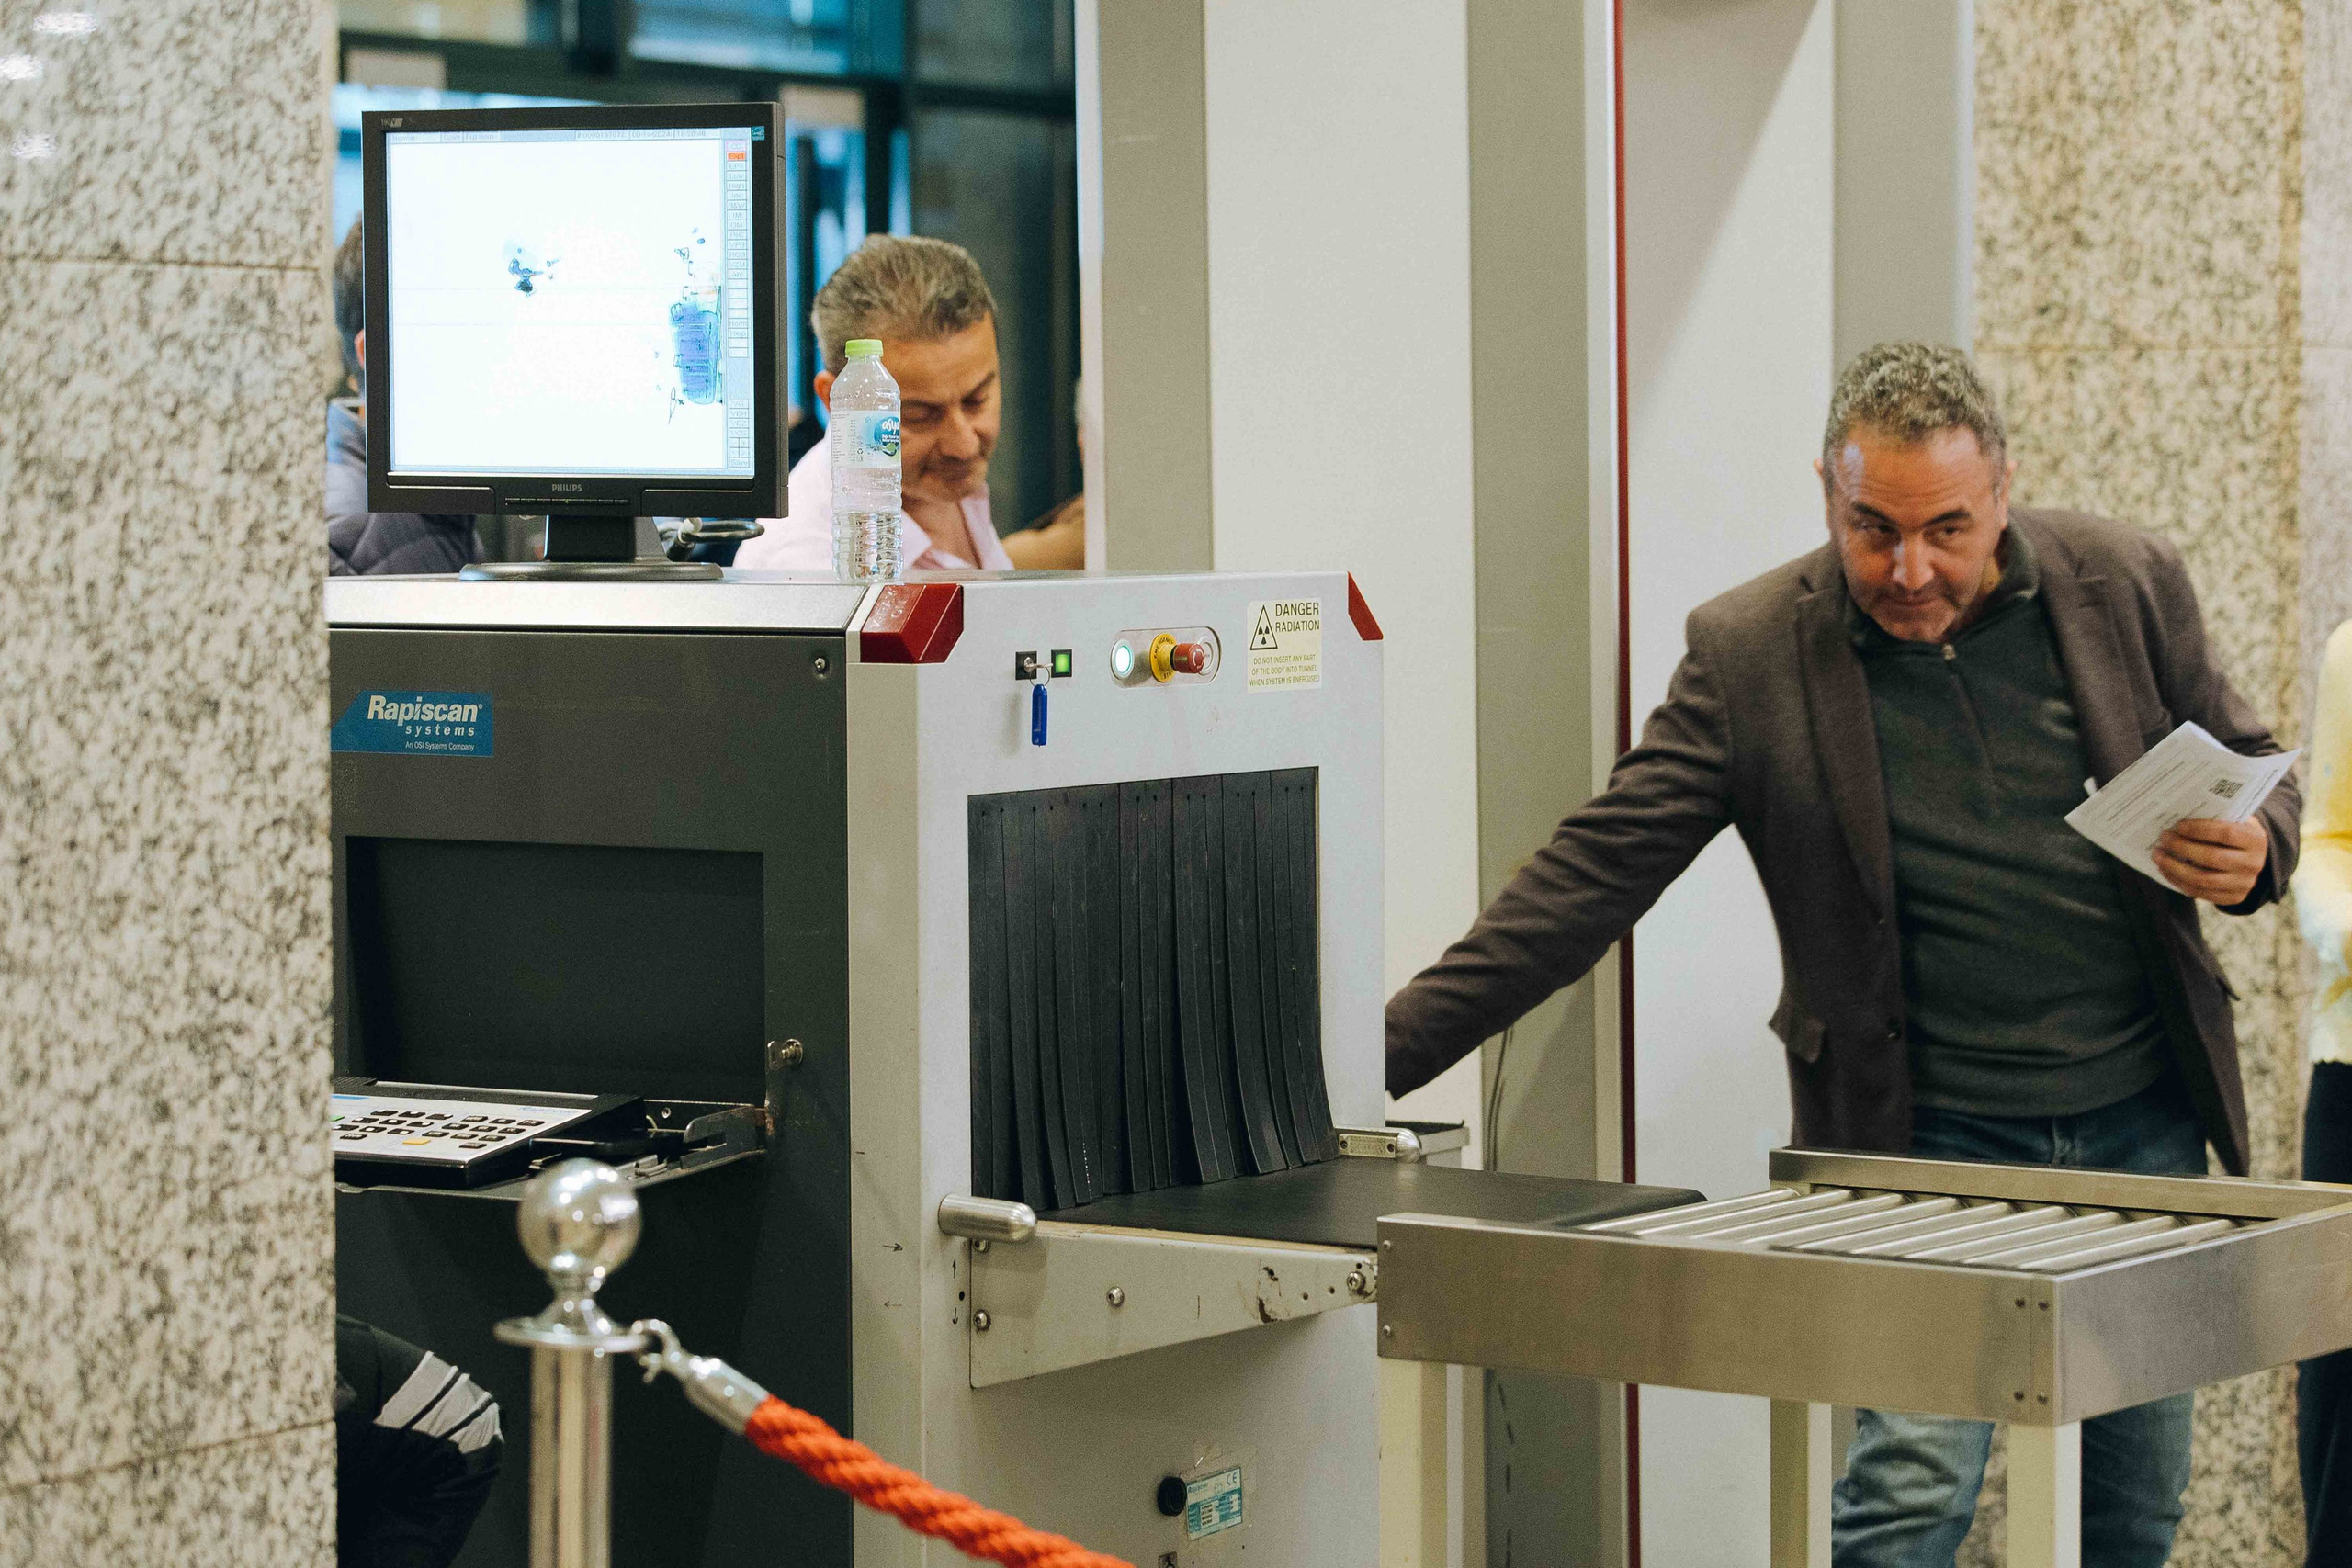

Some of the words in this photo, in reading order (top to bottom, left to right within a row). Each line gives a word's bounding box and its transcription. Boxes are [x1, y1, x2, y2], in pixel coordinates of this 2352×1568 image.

[551, 483, 582, 492] PHILIPS
[1275, 602, 1319, 616] DANGER
[1275, 619, 1319, 633] RADIATION
[1253, 657, 1261, 665] DO
[1261, 656, 1272, 664] NOT
[1273, 655, 1291, 663] INSERT
[1251, 668, 1259, 676] OF
[1260, 667, 1270, 675] THE
[1271, 666, 1284, 674] BODY
[1285, 665, 1297, 673] INTO
[1298, 664, 1317, 672] TUNNEL
[1249, 679, 1265, 687] WHEN
[1265, 677, 1285, 685] SYSTEM
[1286, 676, 1292, 684] IS
[1292, 674, 1320, 683] ENERGISED
[368, 695, 479, 727] Rapiscan
[405, 723, 475, 738] systems
[424, 742, 447, 750] Systems
[448, 742, 475, 751] Company
